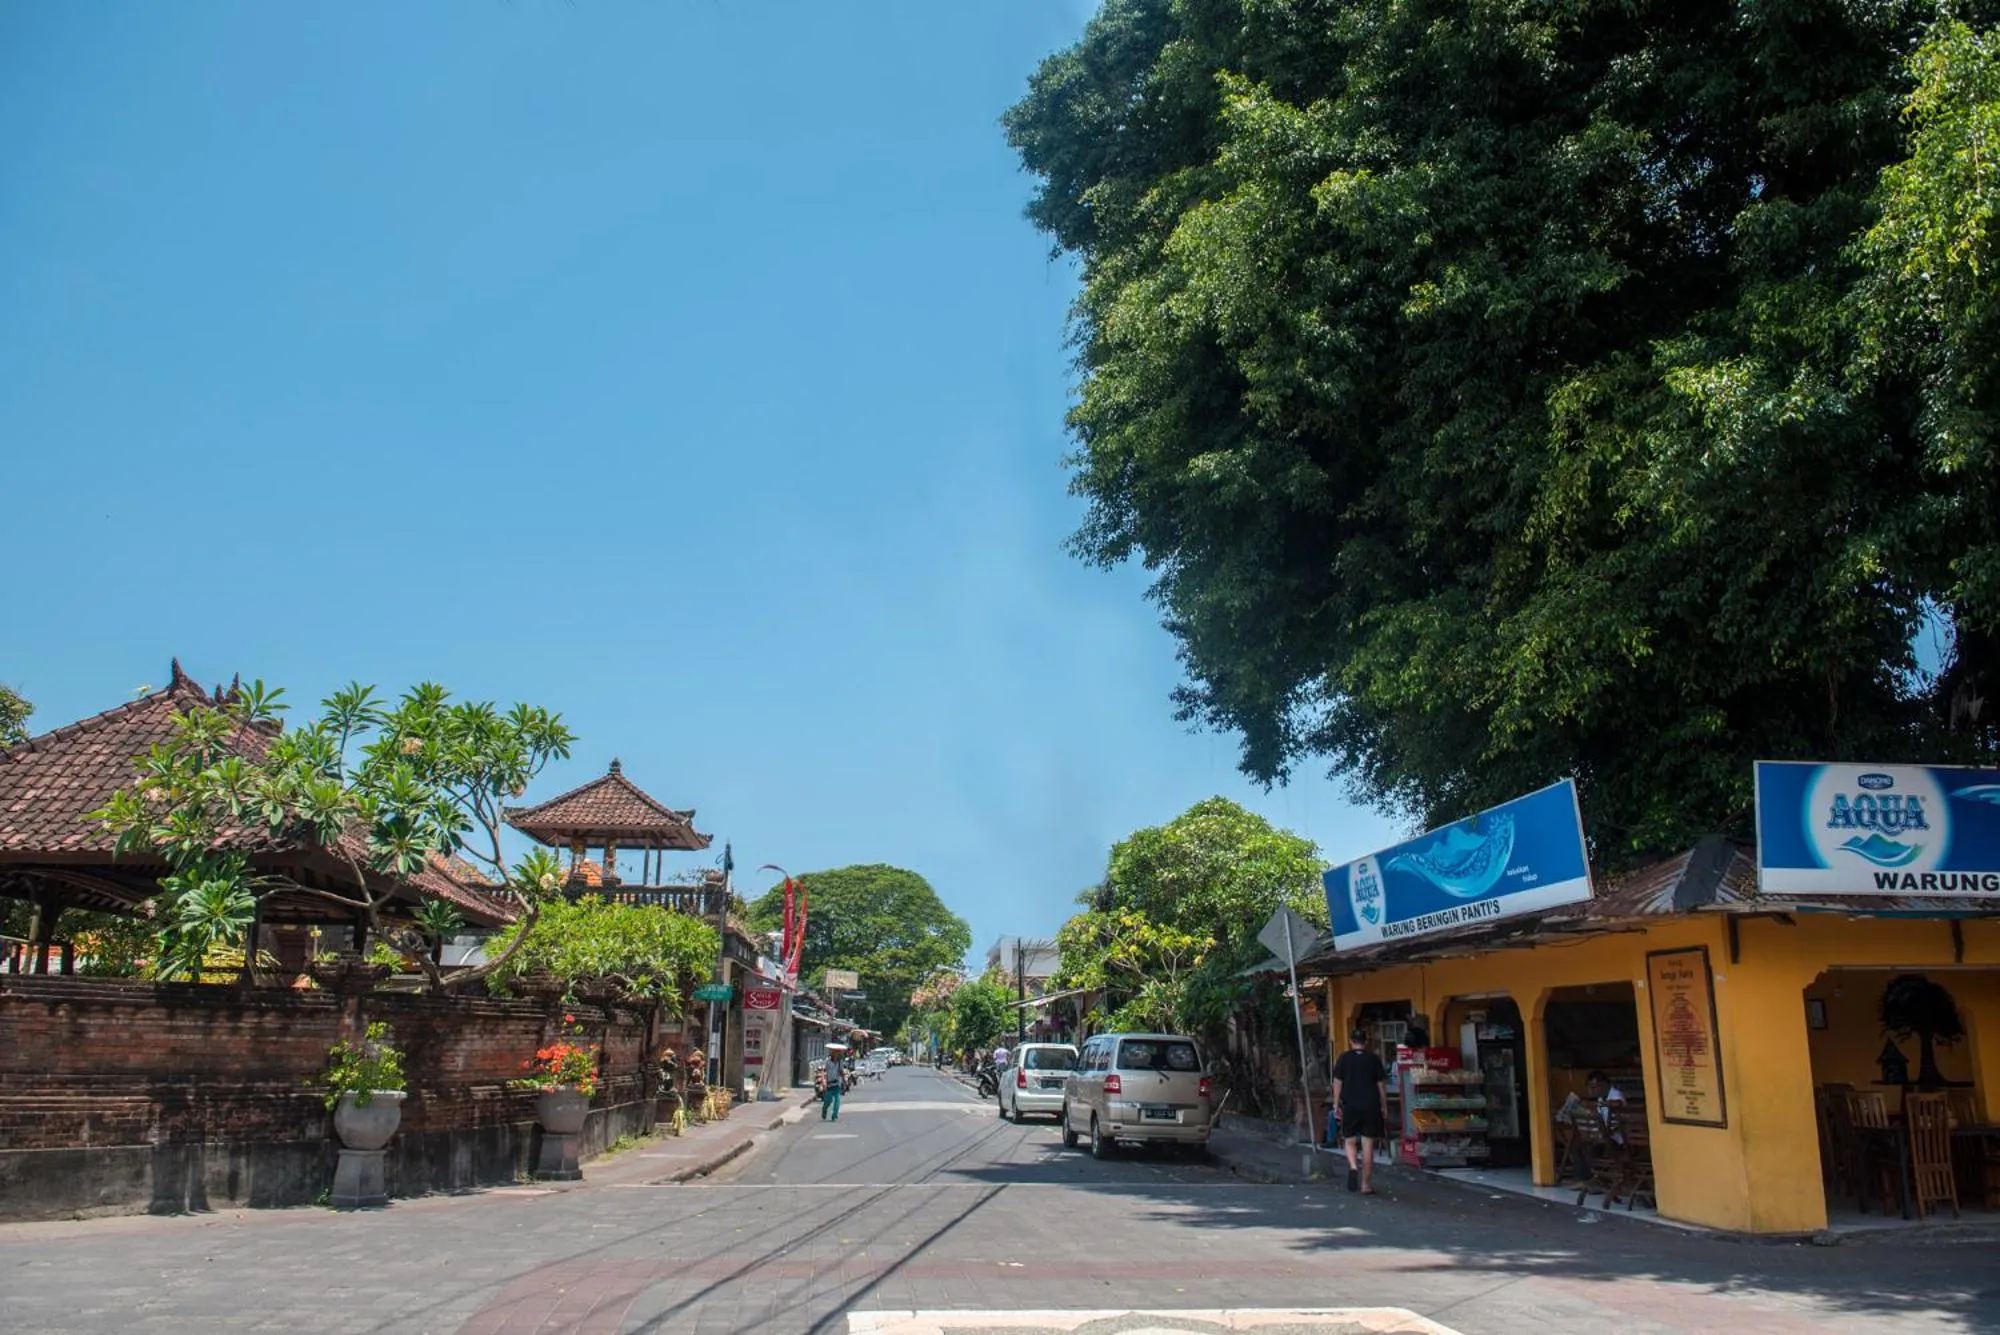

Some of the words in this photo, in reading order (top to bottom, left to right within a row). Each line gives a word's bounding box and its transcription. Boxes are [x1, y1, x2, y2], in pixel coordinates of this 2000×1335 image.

[1827, 793, 1929, 836] AQUA
[1874, 872, 2000, 891] WARUNG
[1381, 924, 1416, 939] WARUNG
[1417, 909, 1460, 931] BERINGIN
[1461, 899, 1500, 922] PANTI'S
